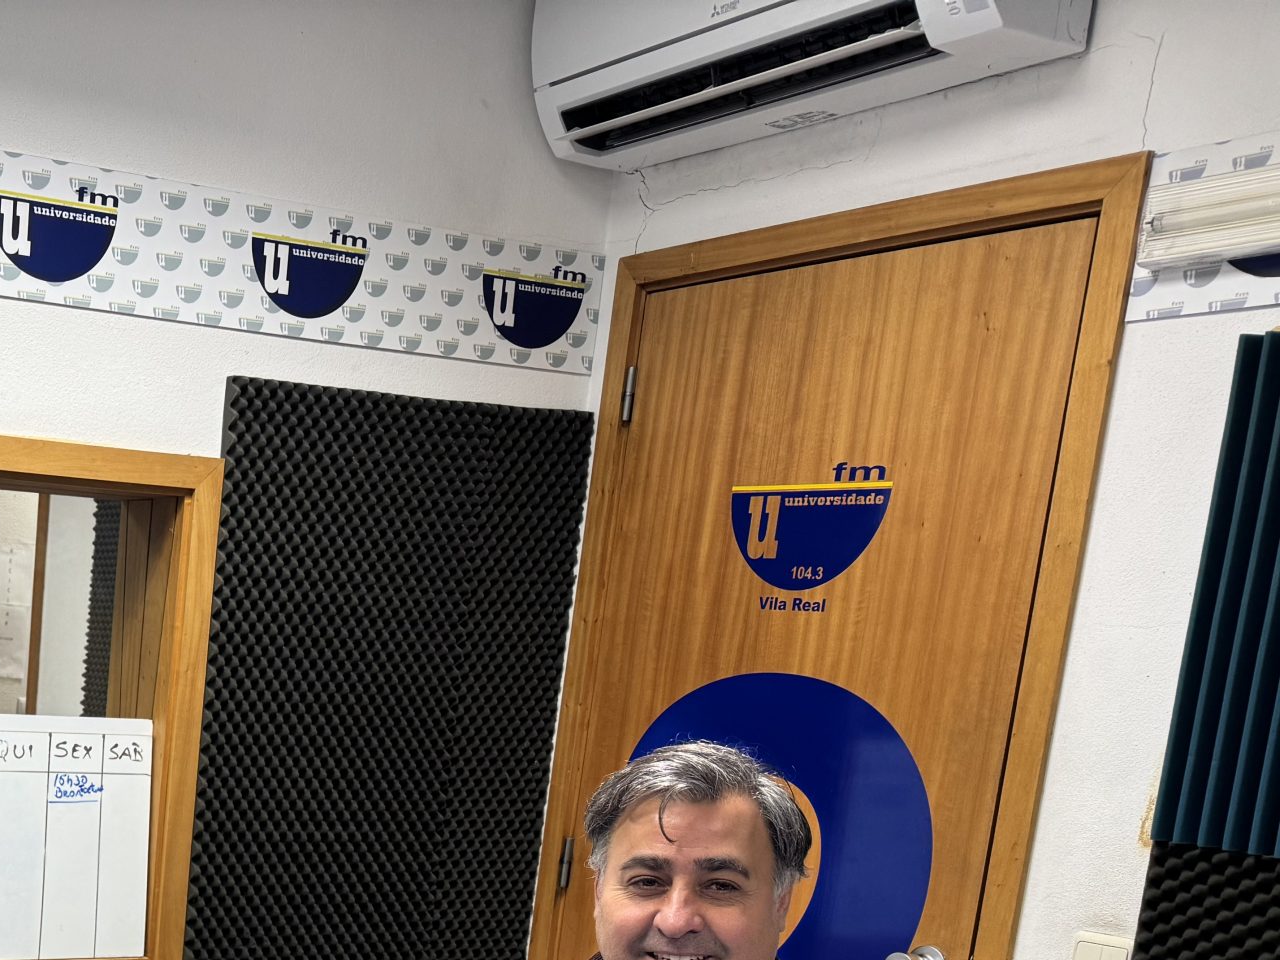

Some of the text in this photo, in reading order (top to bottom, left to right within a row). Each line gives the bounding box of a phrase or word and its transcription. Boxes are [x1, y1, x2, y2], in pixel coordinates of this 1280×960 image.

[76, 186, 119, 208] fm
[33, 206, 116, 227] universidade
[1, 198, 31, 257] u
[330, 229, 367, 248] fm
[292, 247, 365, 266] universidade
[264, 241, 290, 295] u
[552, 266, 586, 283] fm
[519, 282, 583, 299] universidade
[493, 278, 515, 327] u
[832, 462, 887, 482] fm
[785, 493, 884, 507] universidade
[747, 496, 781, 559] u
[791, 566, 823, 580] 104.3
[759, 597, 827, 613] Vila Real
[54, 741, 92, 759] SEX
